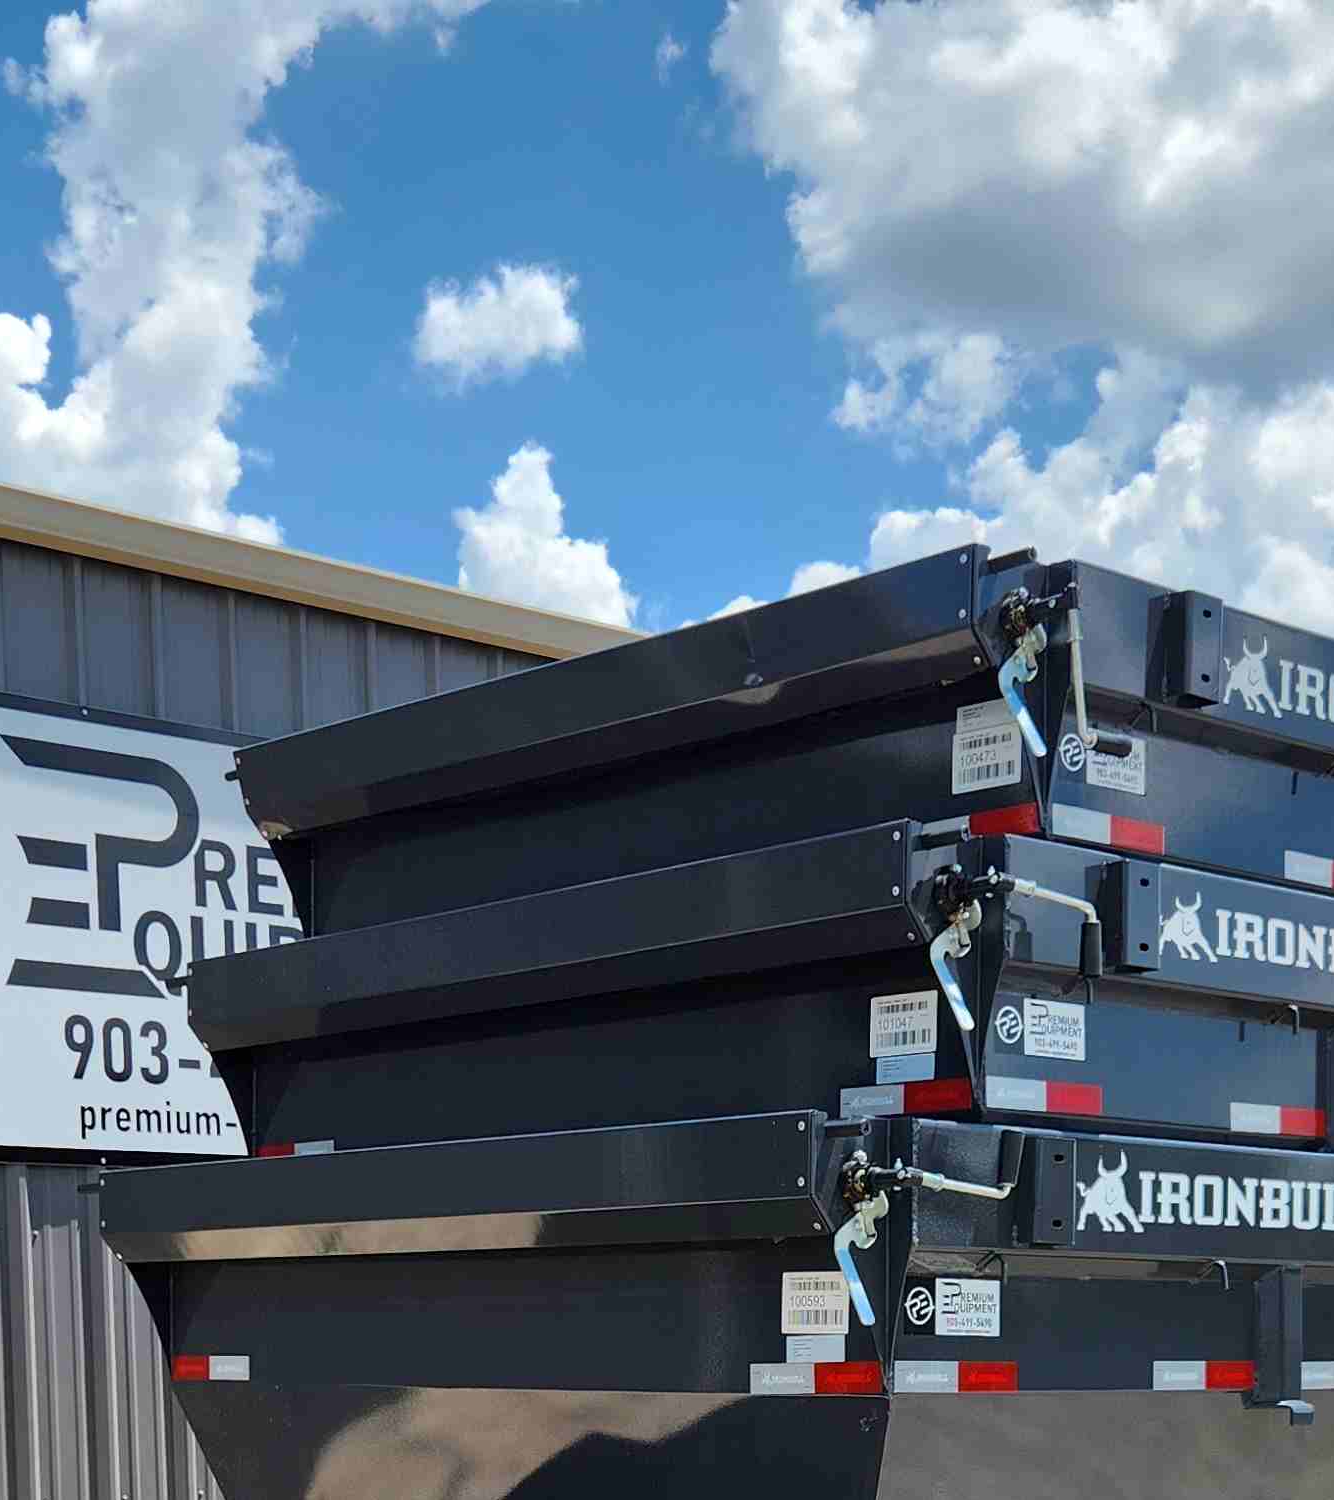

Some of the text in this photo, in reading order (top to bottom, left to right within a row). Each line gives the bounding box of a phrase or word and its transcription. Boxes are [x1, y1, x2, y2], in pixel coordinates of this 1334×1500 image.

[878, 1016, 912, 1032] 101047
[64, 1014, 221, 1086] 903-
[79, 1100, 237, 1140] premium-
[789, 1295, 826, 1307] 100593
[941, 1281, 995, 1307] PREMIUM
[941, 1294, 997, 1315] EQUIPMENT
